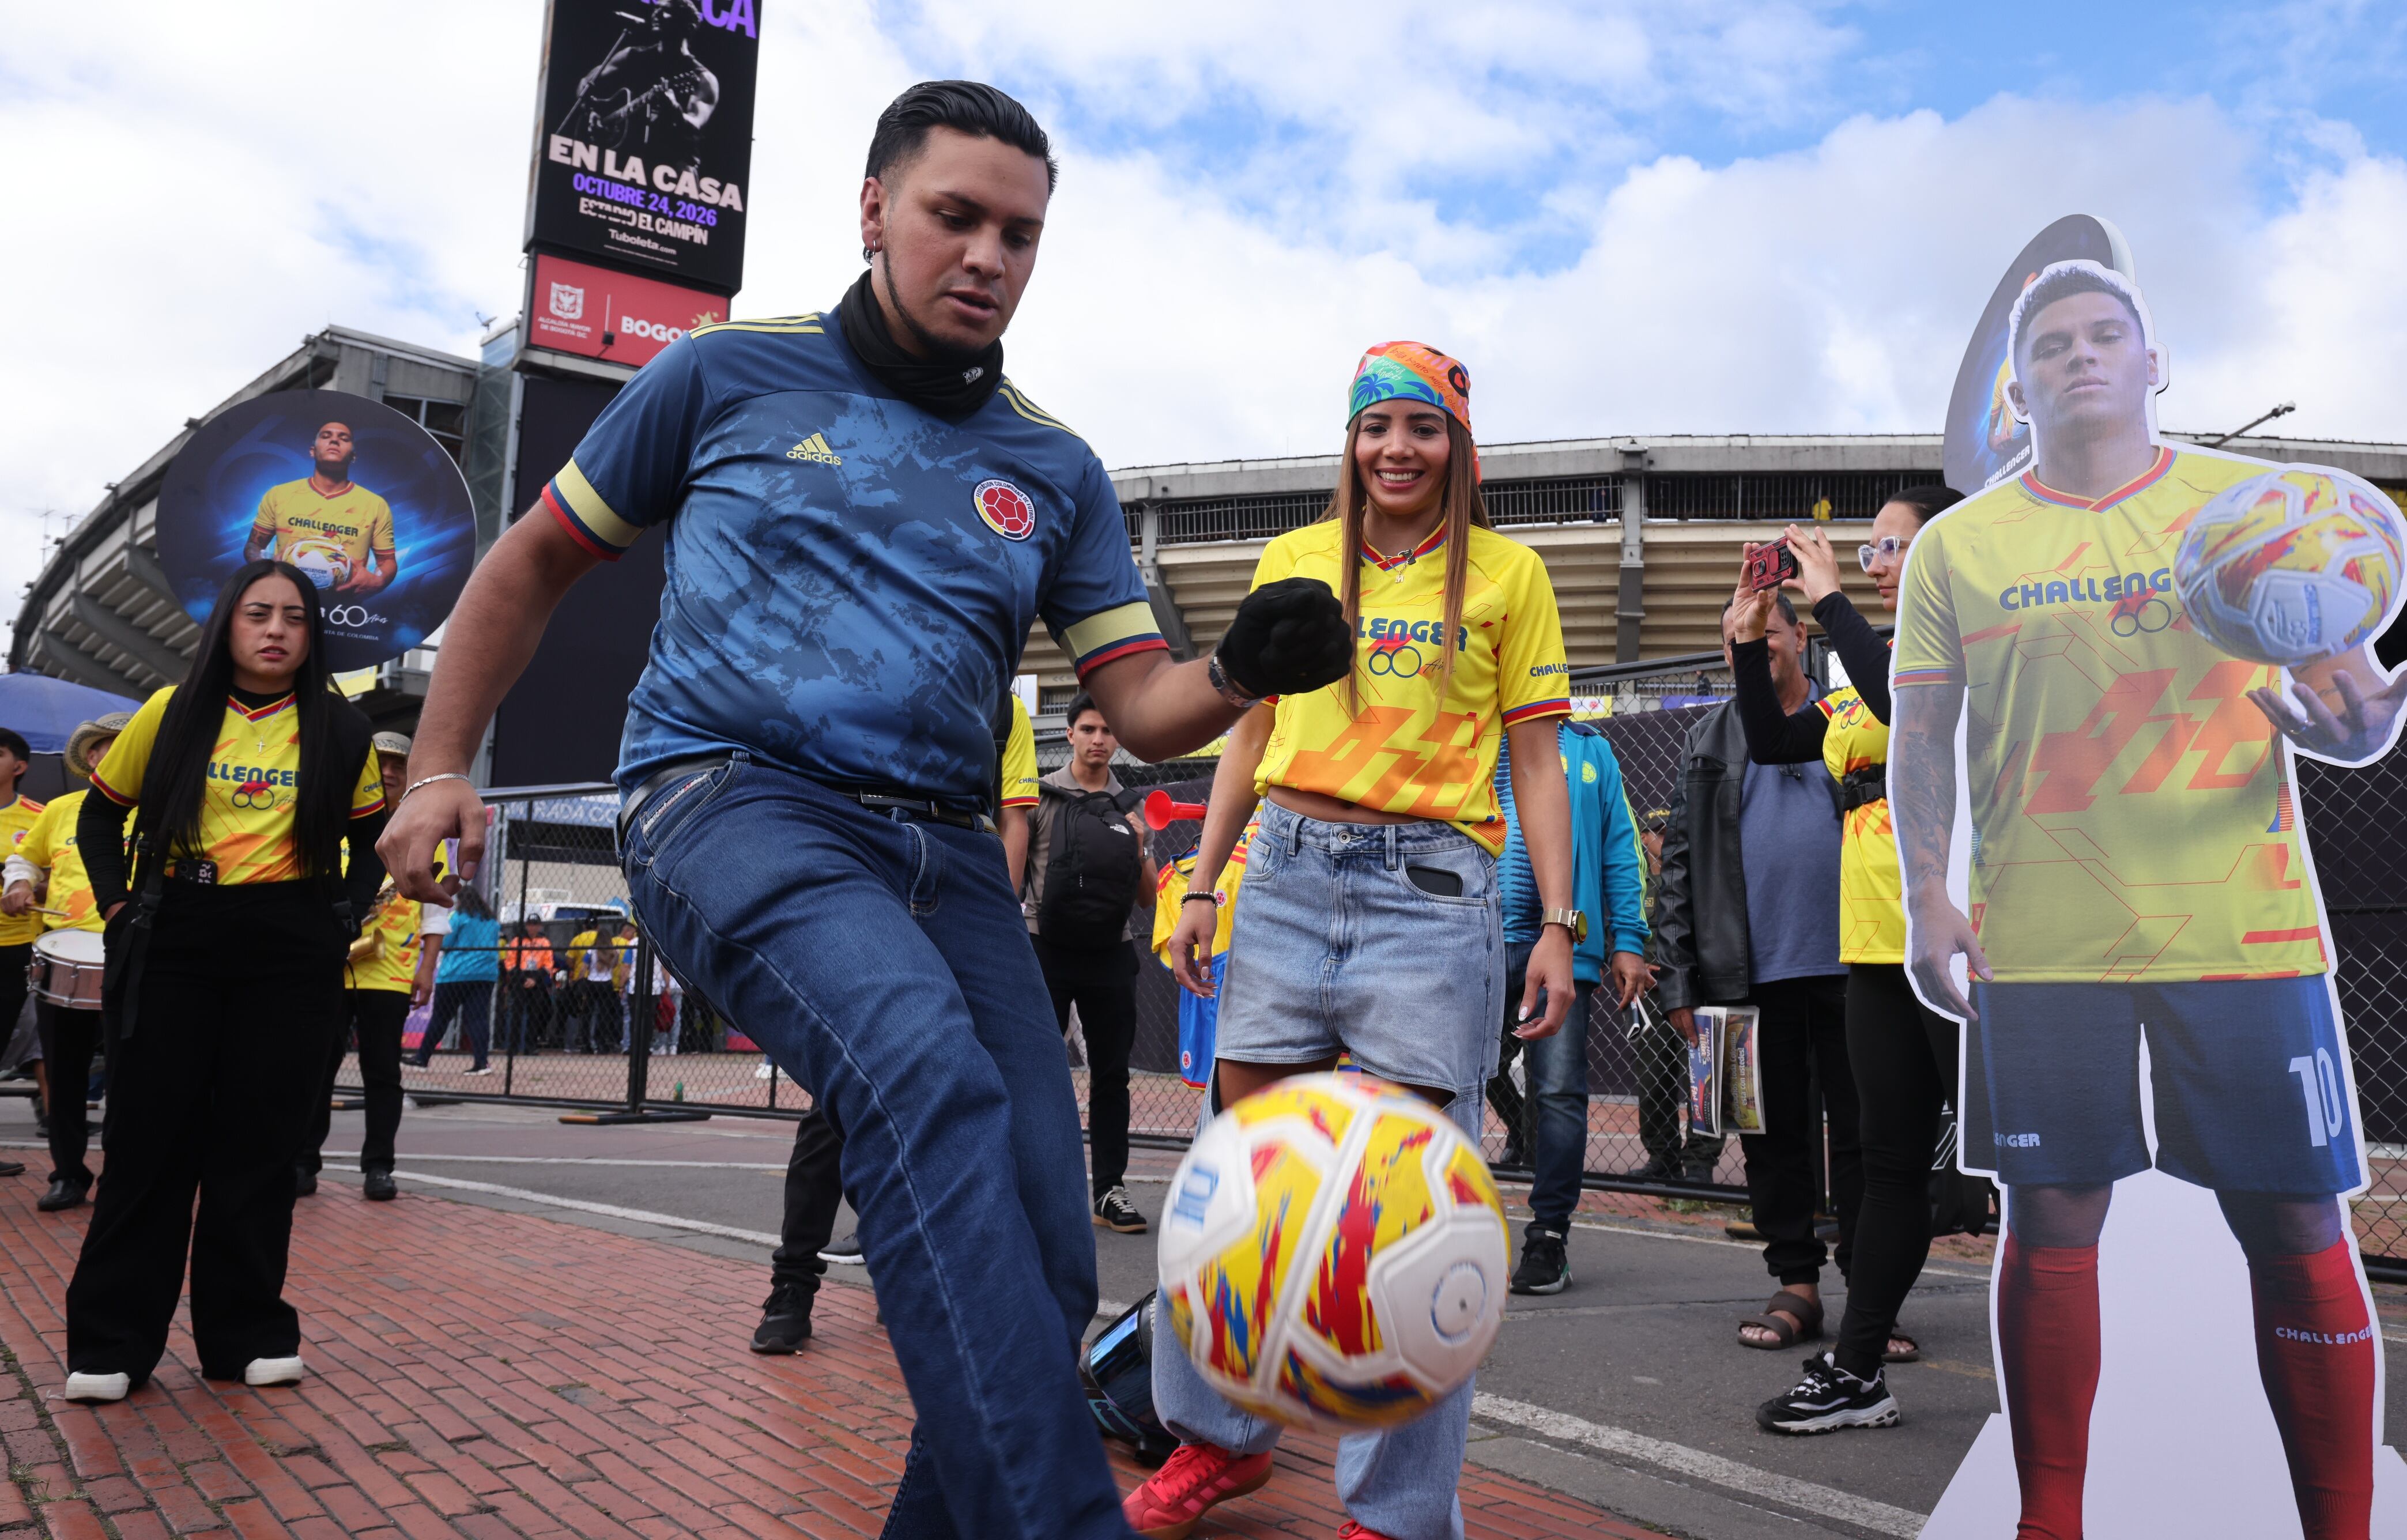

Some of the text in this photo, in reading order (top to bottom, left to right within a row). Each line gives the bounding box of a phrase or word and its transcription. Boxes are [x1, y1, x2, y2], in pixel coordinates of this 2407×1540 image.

[549, 134, 744, 213] EN LA CASA
[573, 172, 718, 227] OCTUBRE 24, 2026
[608, 228, 677, 255] Tuboleta.com
[637, 212, 654, 232] EL
[655, 219, 708, 246] CAMPÍN
[786, 451, 842, 466] adidas
[1985, 445, 2030, 488] CHALLENGER
[288, 517, 359, 537] CHALLENGER
[1999, 567, 2171, 611] CHALLENG
[329, 604, 368, 627] 60
[2111, 598, 2172, 637] 60
[1369, 644, 1422, 678] 60
[232, 786, 274, 810] 60
[2288, 1047, 2343, 1147] 10
[1993, 1132, 2040, 1148] ENGER
